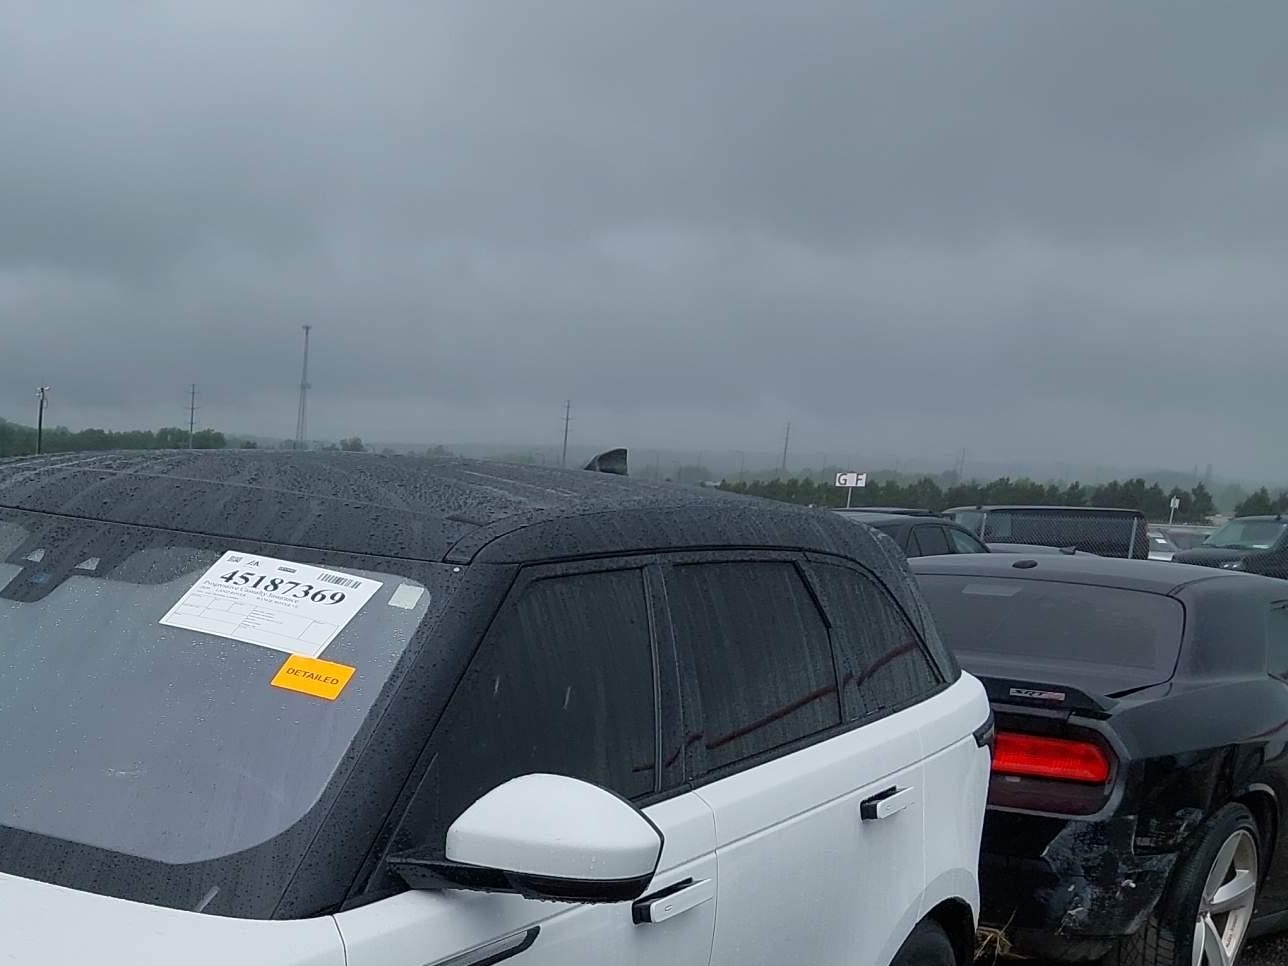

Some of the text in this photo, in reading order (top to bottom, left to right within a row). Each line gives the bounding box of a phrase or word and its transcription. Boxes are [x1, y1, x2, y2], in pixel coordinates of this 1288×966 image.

[838, 473, 864, 486] G F
[220, 569, 346, 606] 45187369
[286, 667, 340, 686] DETAILED
